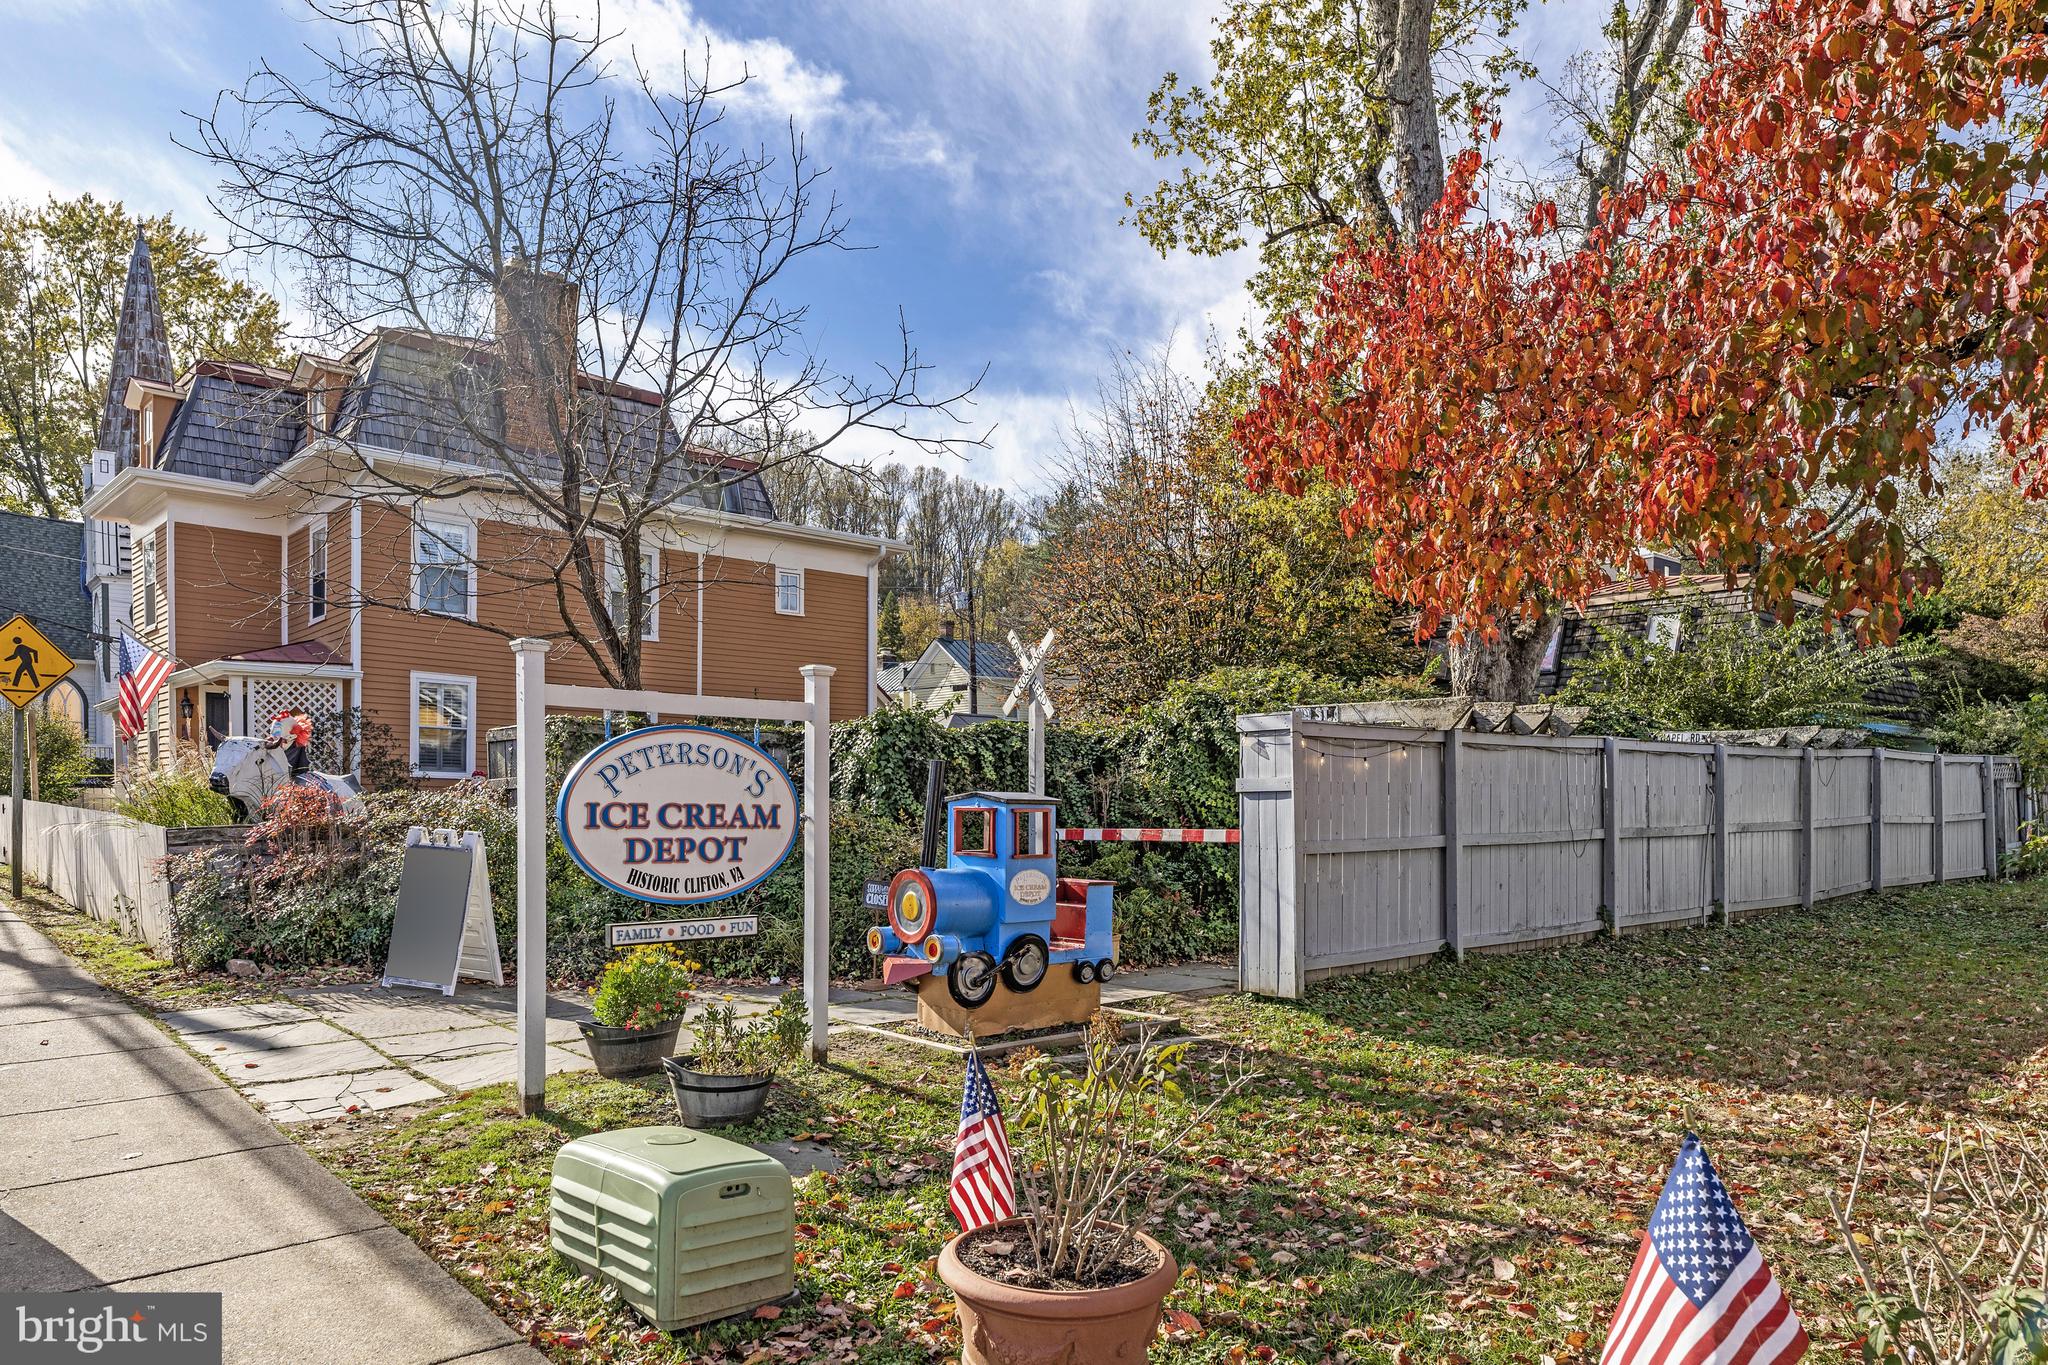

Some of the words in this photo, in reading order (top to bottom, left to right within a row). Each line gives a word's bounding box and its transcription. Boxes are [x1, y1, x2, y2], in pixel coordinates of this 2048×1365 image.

[1013, 646, 1044, 698] CROSSING
[1031, 676, 1046, 705] HEAD
[1690, 733, 1700, 742] RD
[596, 742, 774, 799] PETERSON'S
[583, 801, 650, 830] ICE
[656, 801, 782, 830] CREAM
[622, 836, 747, 865] DEPOT
[626, 867, 680, 894] HISTORIC
[684, 873, 730, 894] CLIFTON,
[729, 866, 745, 882] VA
[616, 927, 662, 942] FAMILY
[680, 923, 715, 938] FOOD
[729, 920, 754, 934] FUN
